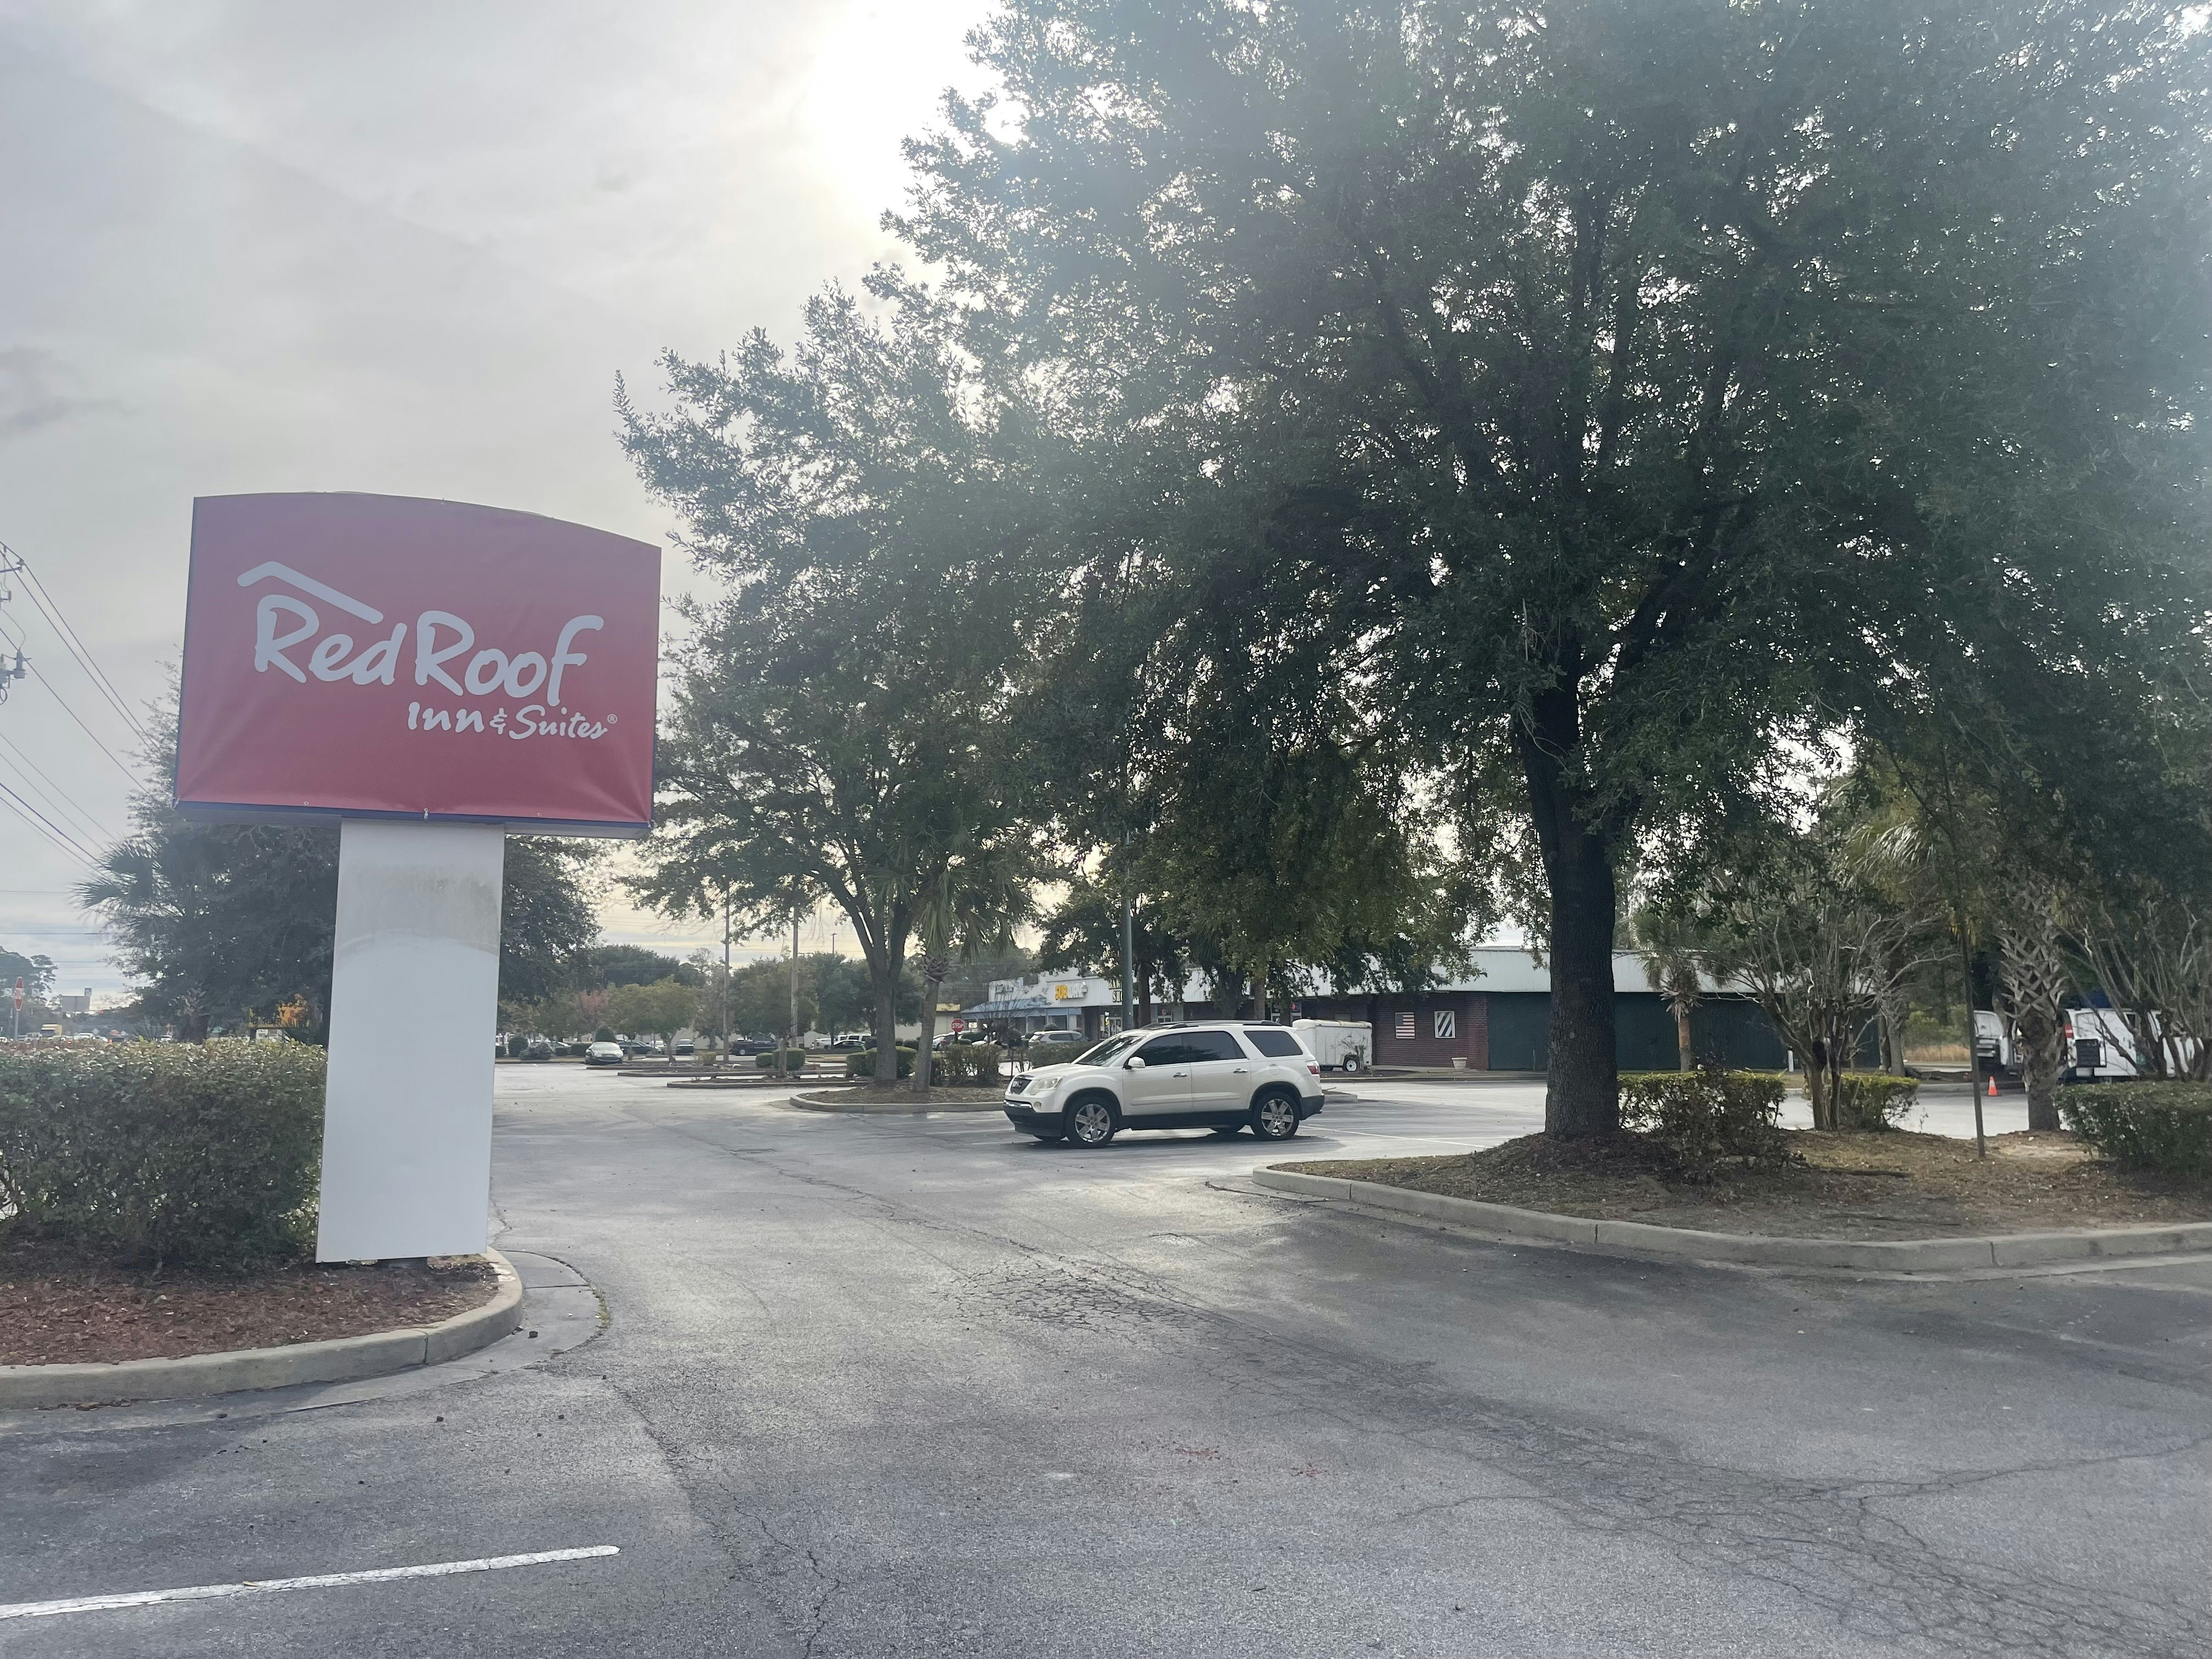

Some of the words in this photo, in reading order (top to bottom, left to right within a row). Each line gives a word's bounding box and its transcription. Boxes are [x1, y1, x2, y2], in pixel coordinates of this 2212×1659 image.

[254, 594, 408, 686] Red
[415, 610, 605, 707] Roof
[408, 702, 485, 733] Inn
[489, 707, 508, 735] &
[1055, 982, 1087, 1000] SUBWAY
